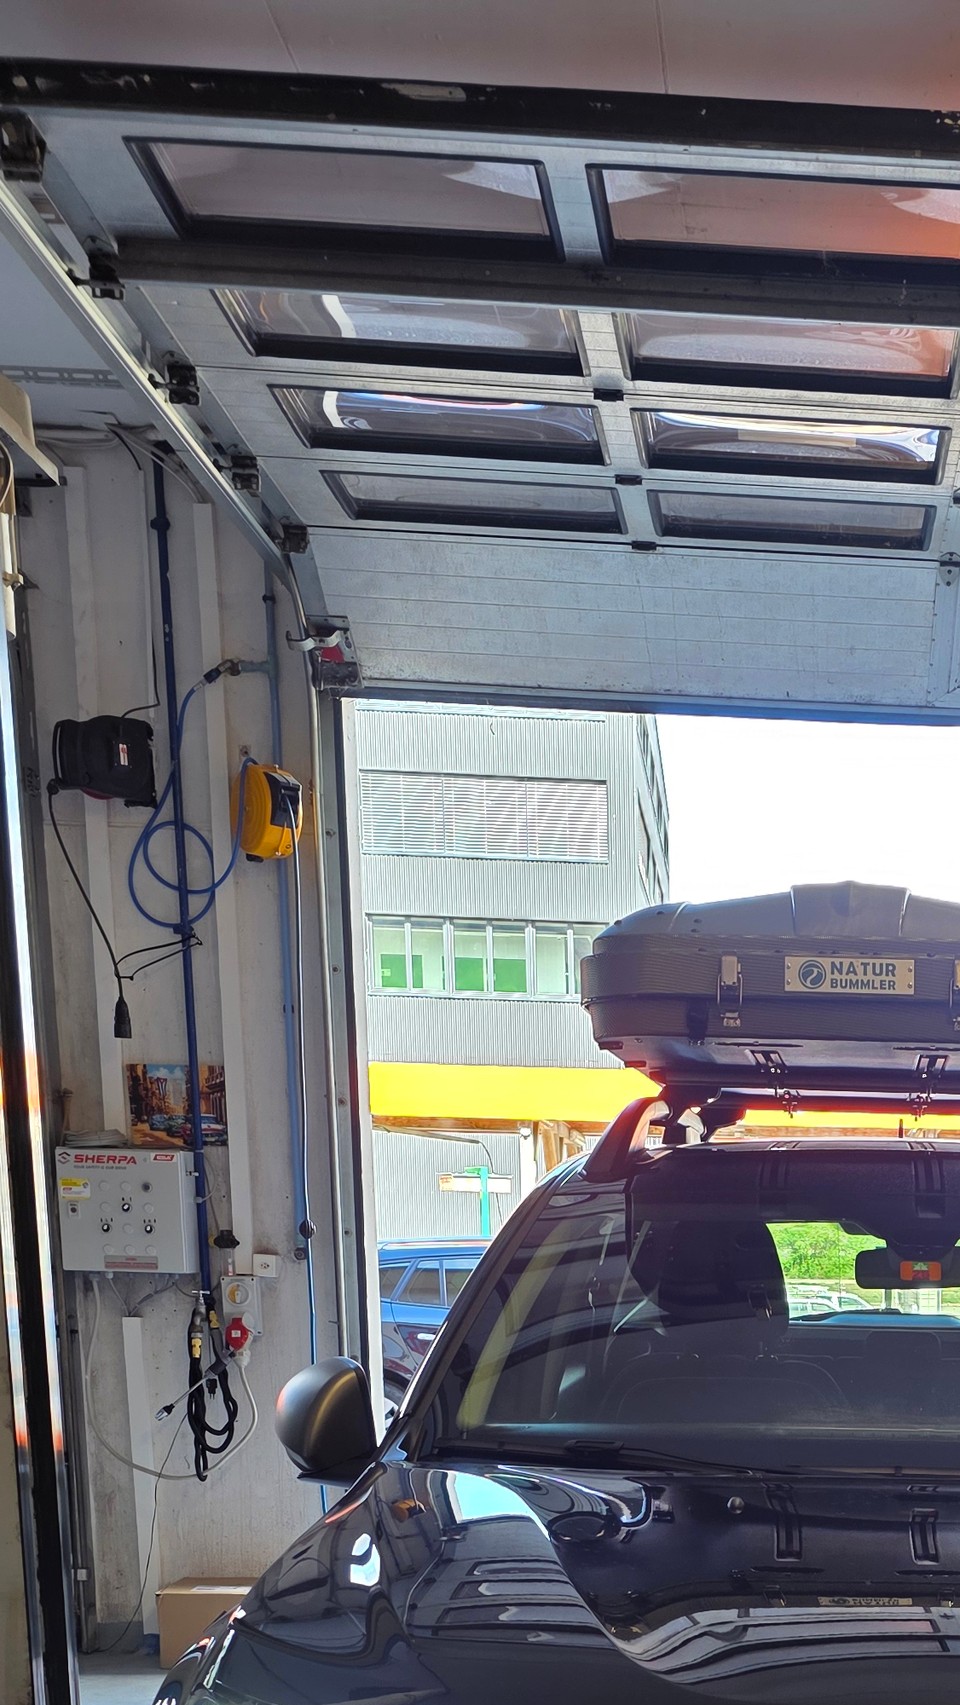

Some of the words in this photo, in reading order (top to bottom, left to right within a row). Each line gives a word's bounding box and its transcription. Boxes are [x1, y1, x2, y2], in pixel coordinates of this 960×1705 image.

[830, 961, 897, 977] NATUR
[830, 978, 896, 991] BUMMLER
[73, 1153, 138, 1165] SHERPA
